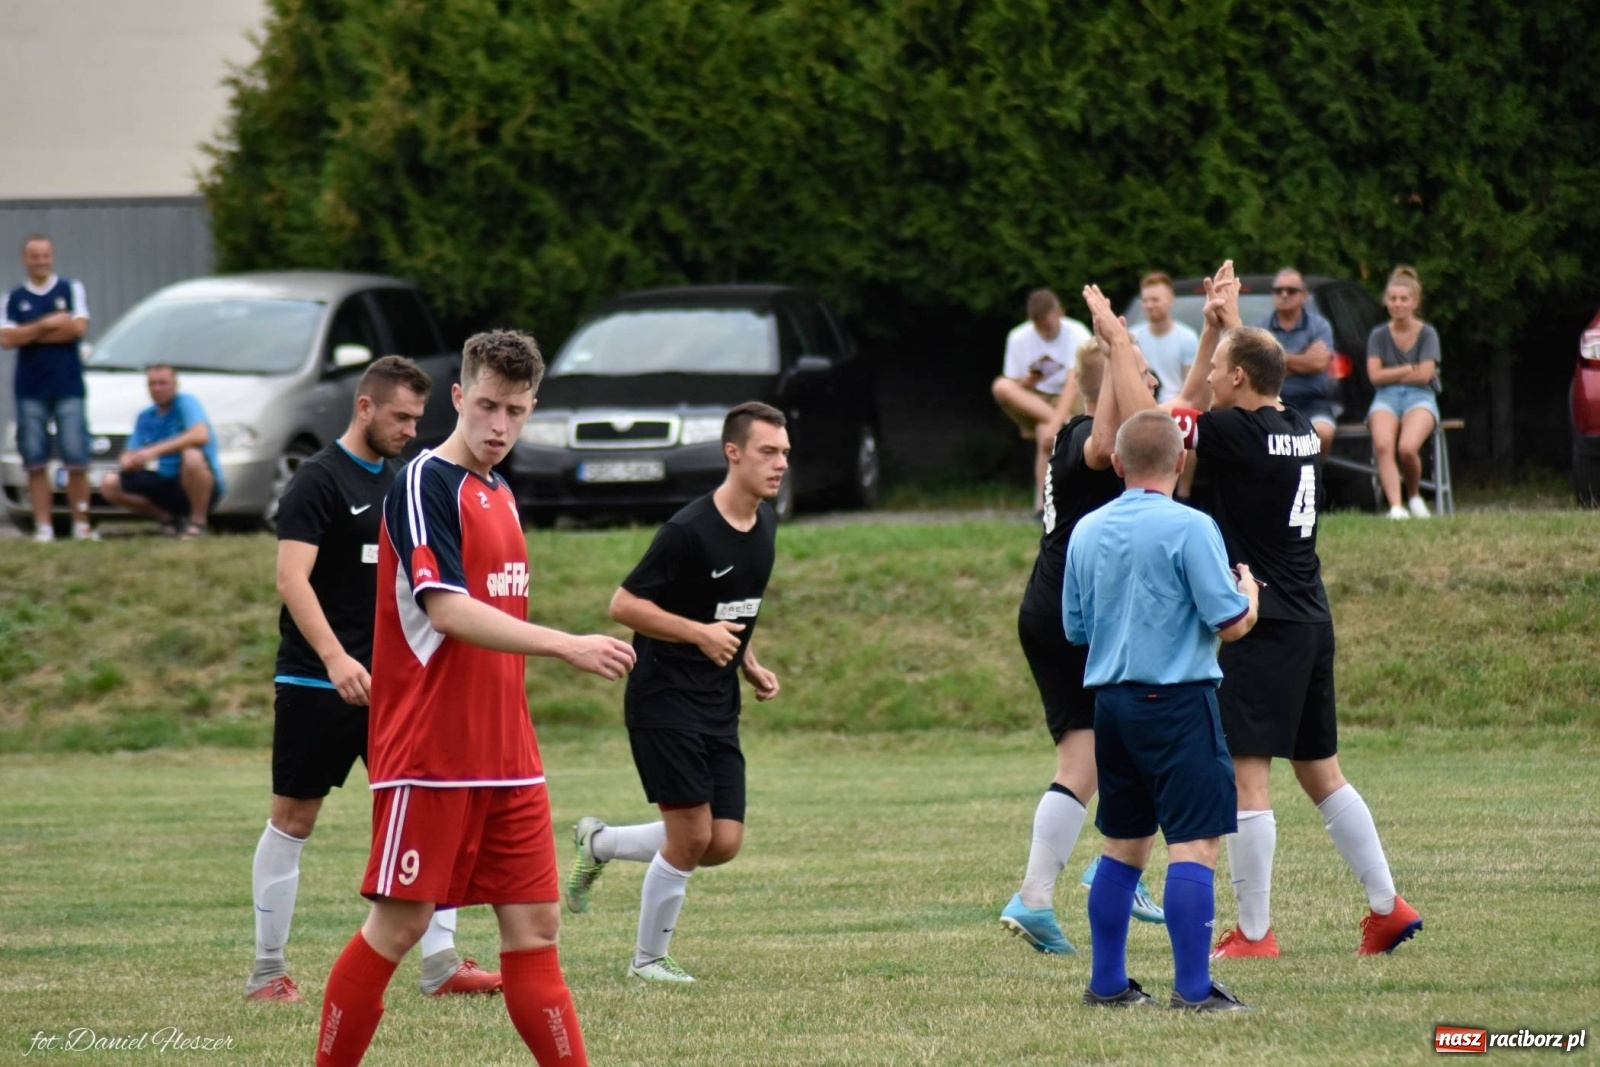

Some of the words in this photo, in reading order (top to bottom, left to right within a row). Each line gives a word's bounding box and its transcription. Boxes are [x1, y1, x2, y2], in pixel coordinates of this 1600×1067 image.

[1267, 434, 1292, 456] LKS
[1288, 464, 1316, 539] 4
[398, 849, 420, 886] 9
[546, 1017, 573, 1060] PATRICK
